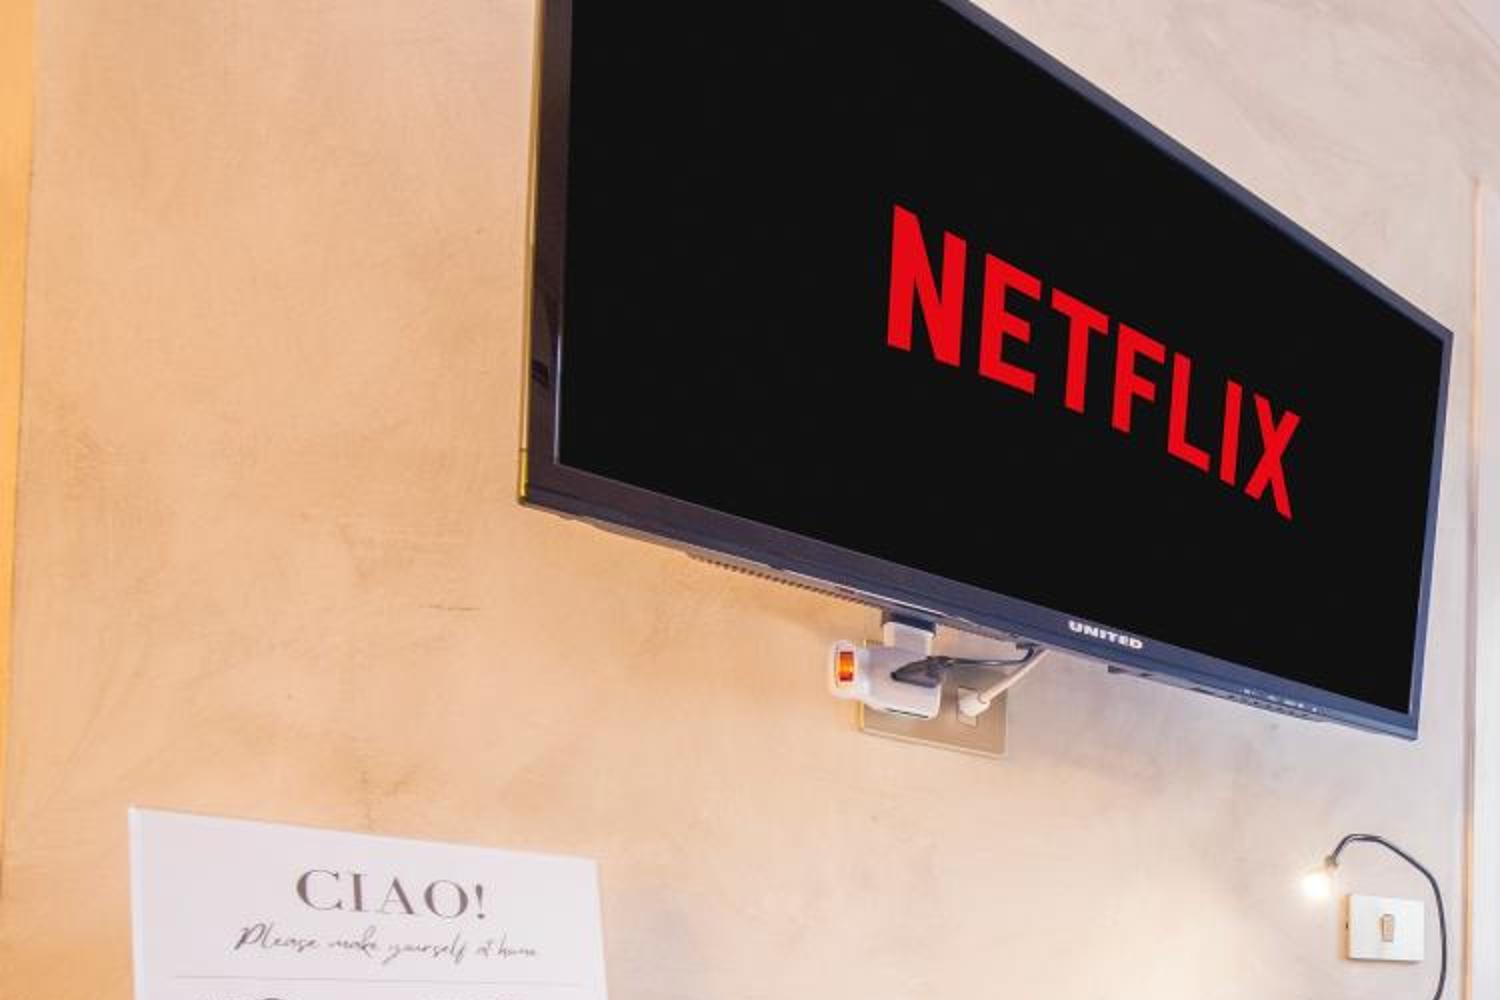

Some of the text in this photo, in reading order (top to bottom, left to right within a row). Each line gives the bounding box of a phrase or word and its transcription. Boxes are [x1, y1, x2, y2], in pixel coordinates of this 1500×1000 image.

[887, 204, 1301, 520] NETFLIX
[1067, 620, 1145, 650] UNITED
[296, 869, 486, 920] CIAO!
[233, 922, 317, 951] Please
[327, 925, 378, 958] make
[382, 933, 465, 966] yourself
